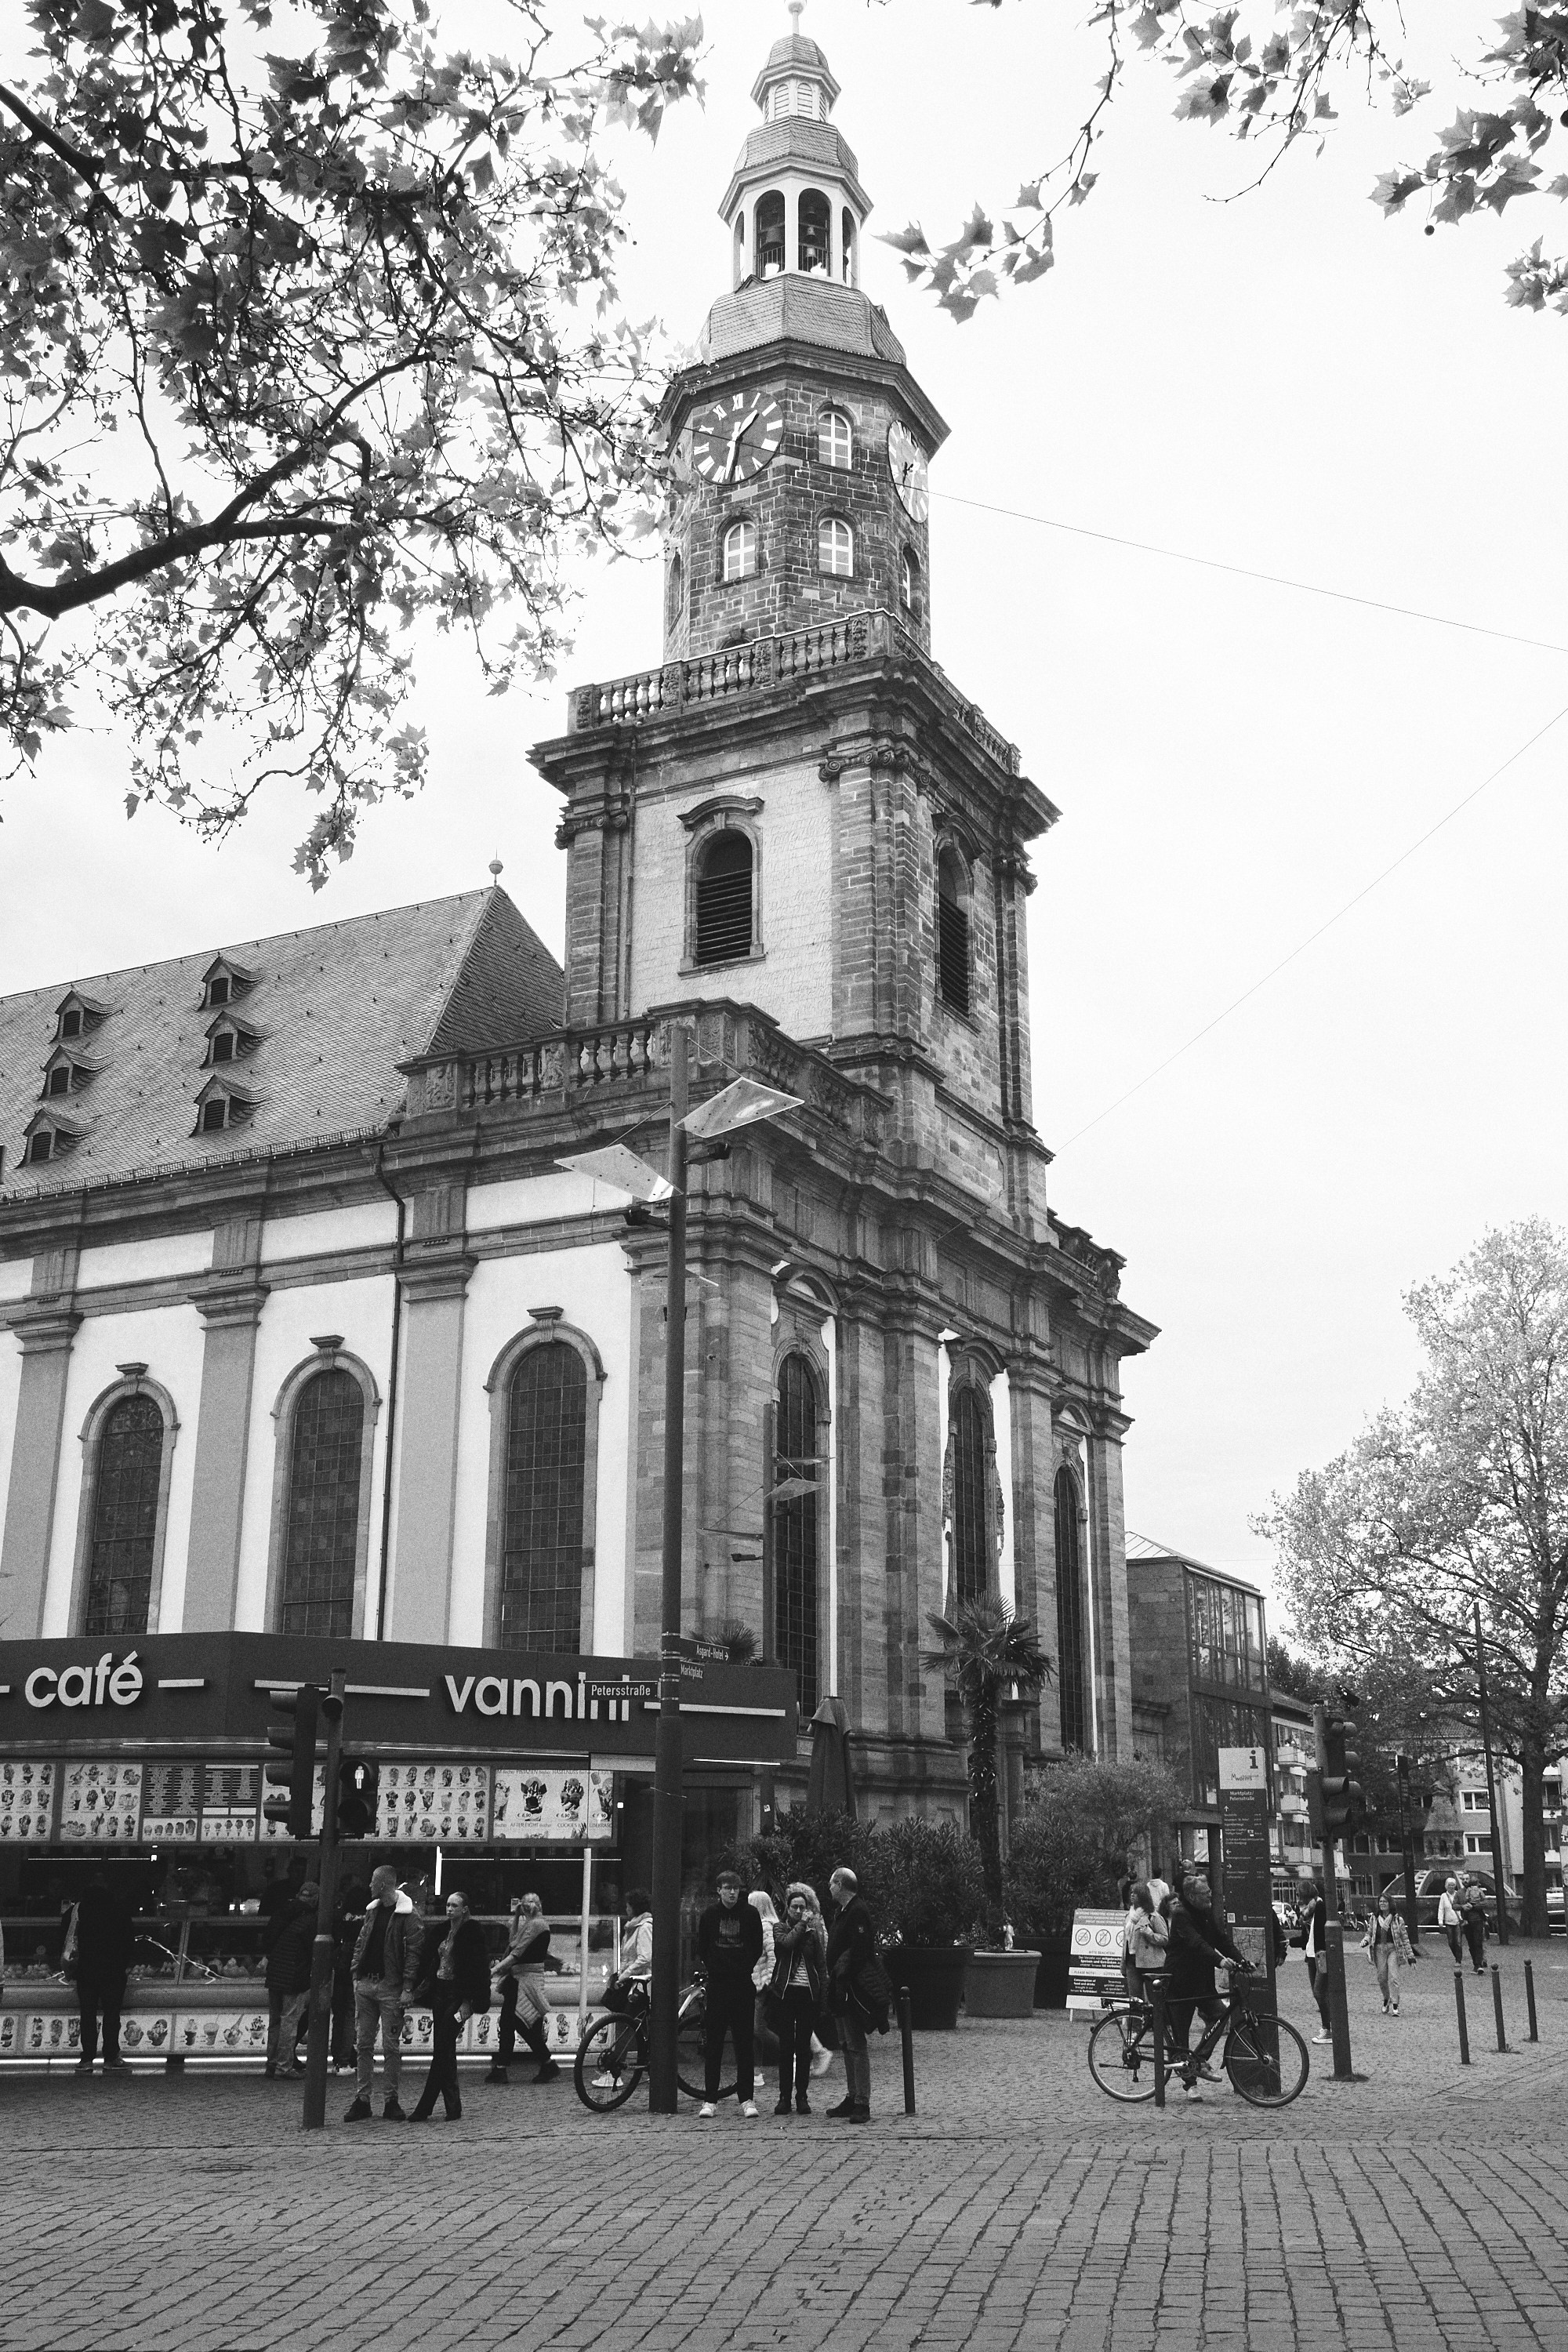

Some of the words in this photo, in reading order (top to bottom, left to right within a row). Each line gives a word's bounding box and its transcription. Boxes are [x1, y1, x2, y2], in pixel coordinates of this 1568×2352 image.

[696, 1644, 724, 1660] Asgard-Hotel
[25, 1650, 143, 1708] café
[681, 1663, 703, 1679] Marktplatz
[591, 1684, 651, 1696] Petersstraße
